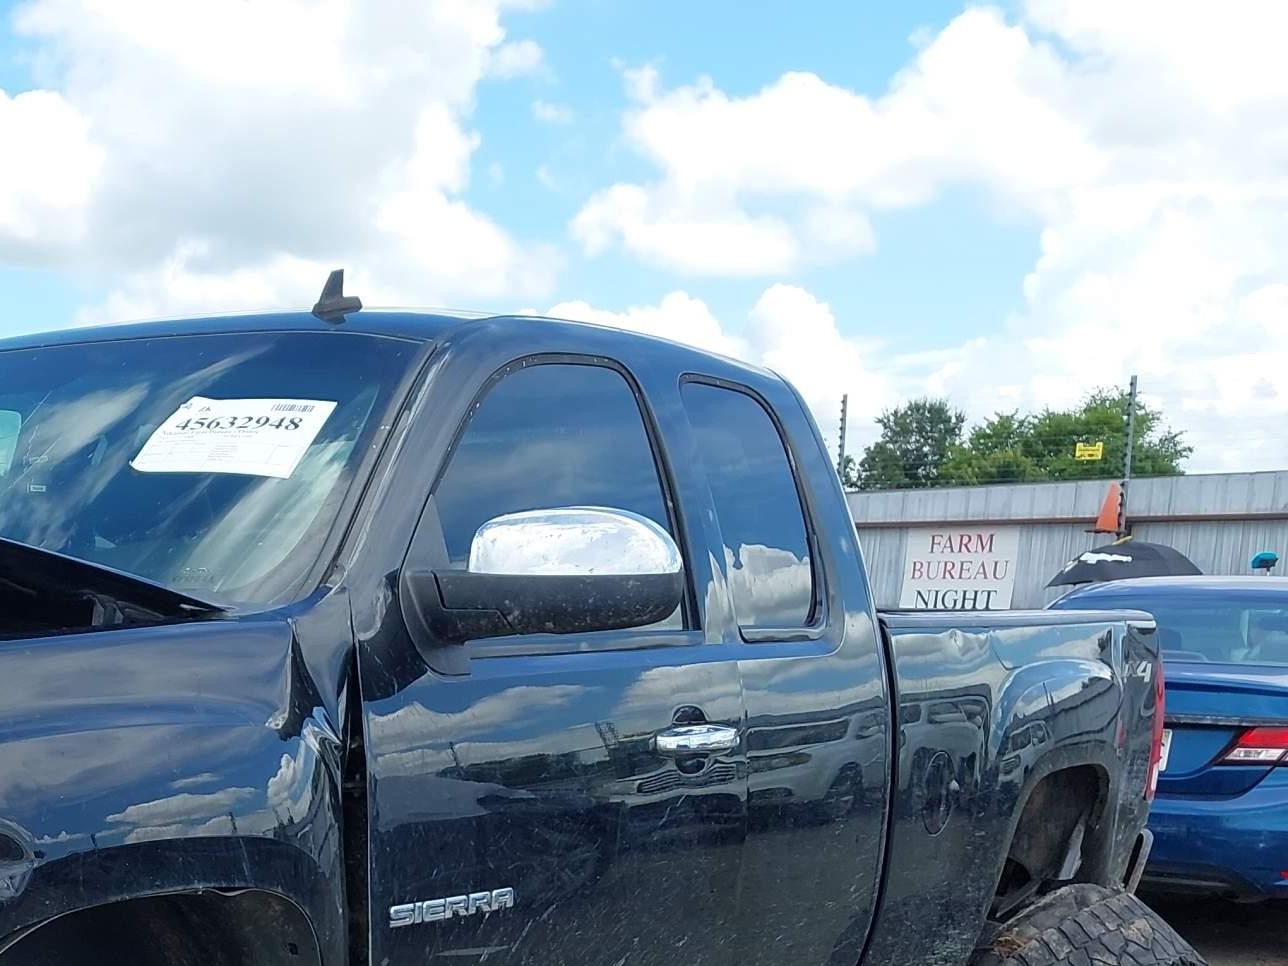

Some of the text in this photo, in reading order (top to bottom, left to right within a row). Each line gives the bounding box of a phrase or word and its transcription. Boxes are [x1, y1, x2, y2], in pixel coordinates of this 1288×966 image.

[175, 415, 304, 431] 45632948
[929, 533, 995, 553] FARM
[911, 559, 1009, 580] BUREAU
[915, 589, 998, 609] NIGHT
[389, 886, 515, 928] SIERRA
